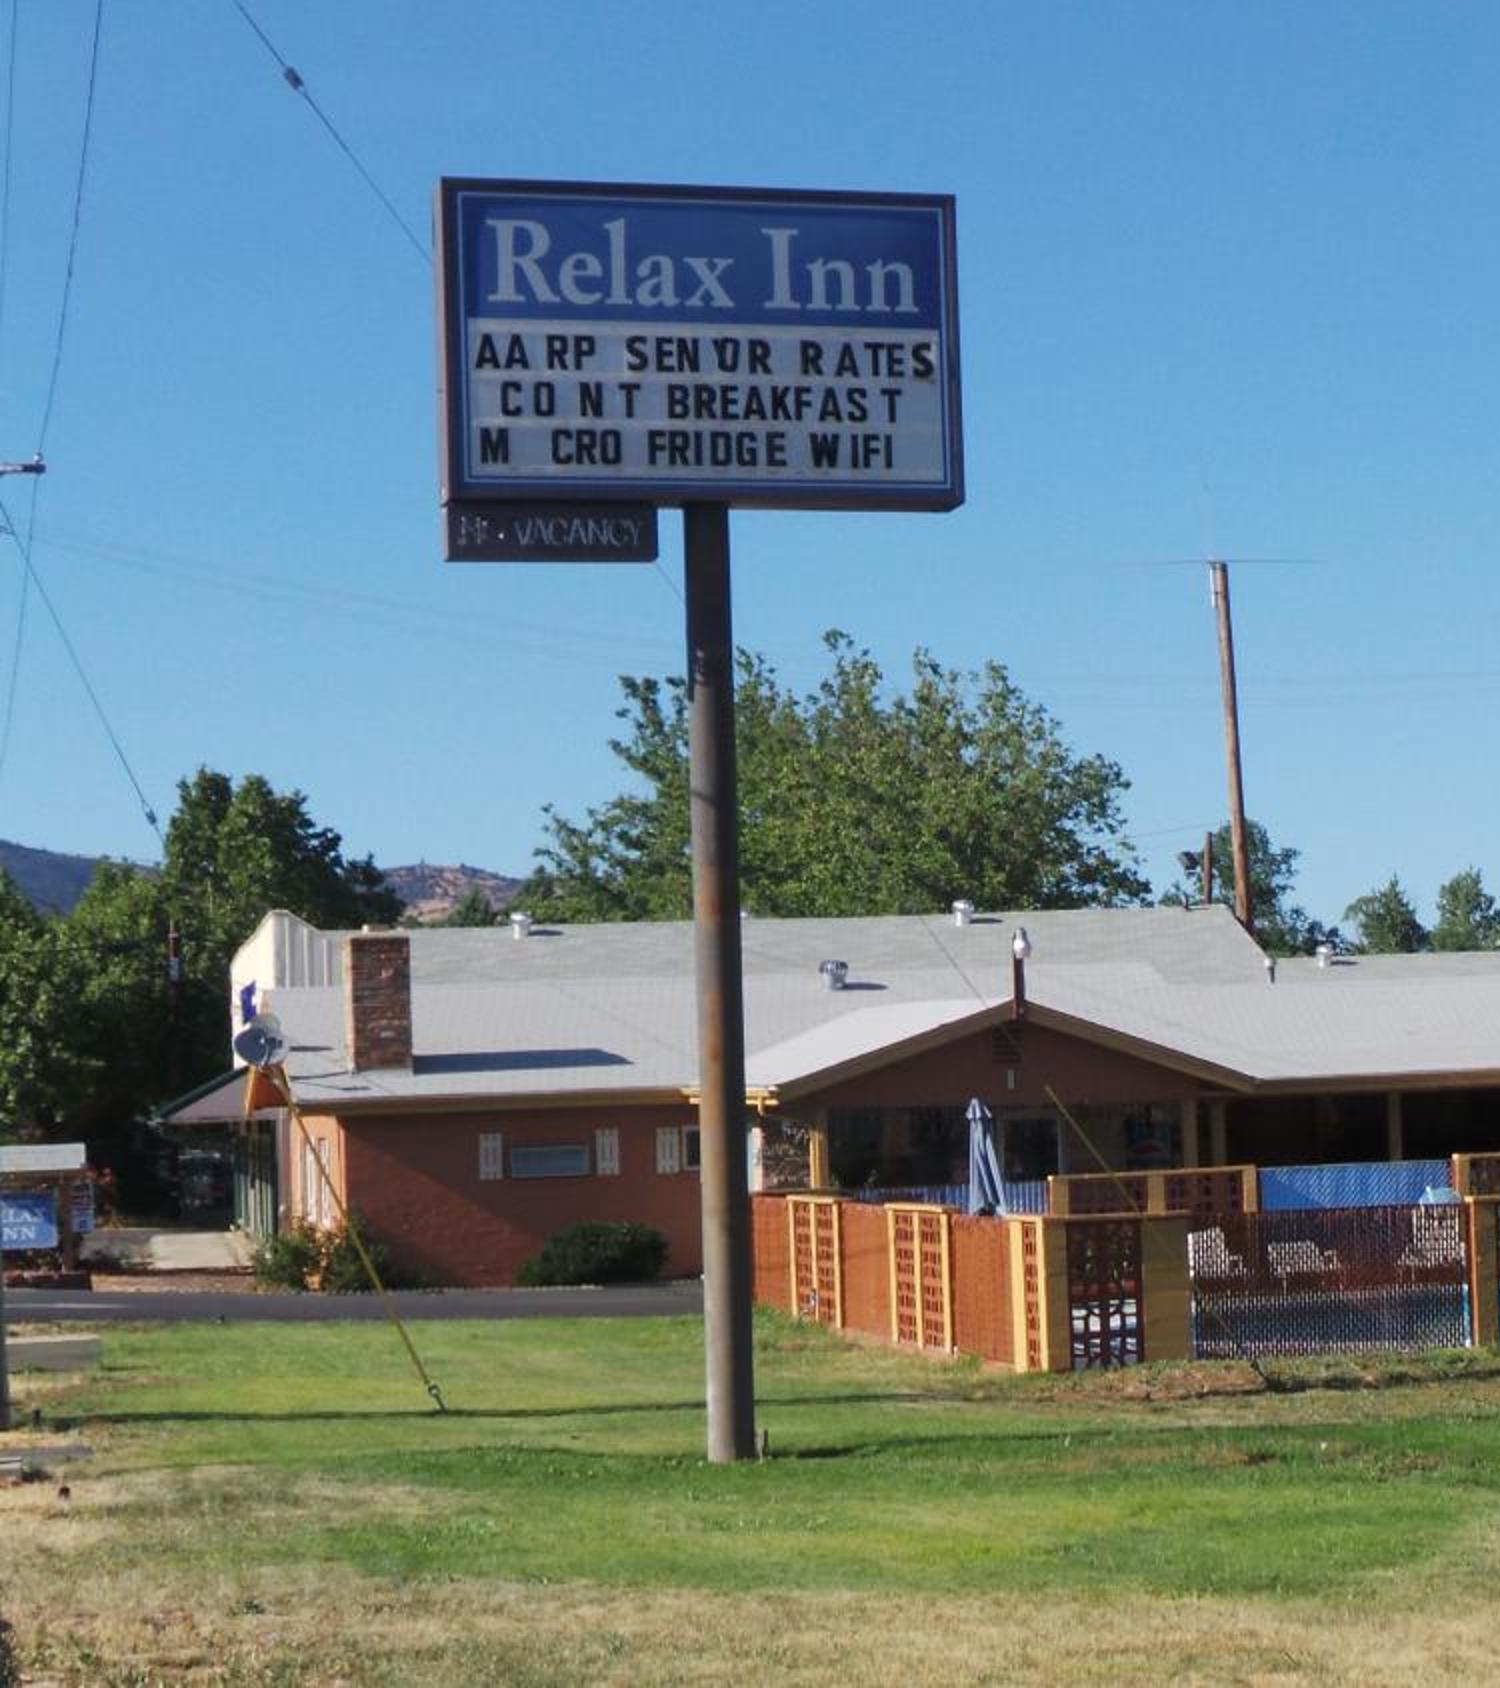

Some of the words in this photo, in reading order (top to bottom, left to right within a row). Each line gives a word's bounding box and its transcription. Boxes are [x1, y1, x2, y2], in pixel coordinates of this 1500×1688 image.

[486, 217, 736, 308] Relax
[760, 227, 919, 313] Inn
[800, 340, 935, 379] RATES
[667, 383, 903, 423] BREAKFAST
[647, 429, 788, 467] FRIDGE
[809, 432, 893, 469] WIFI
[514, 516, 642, 545] VACANCY
